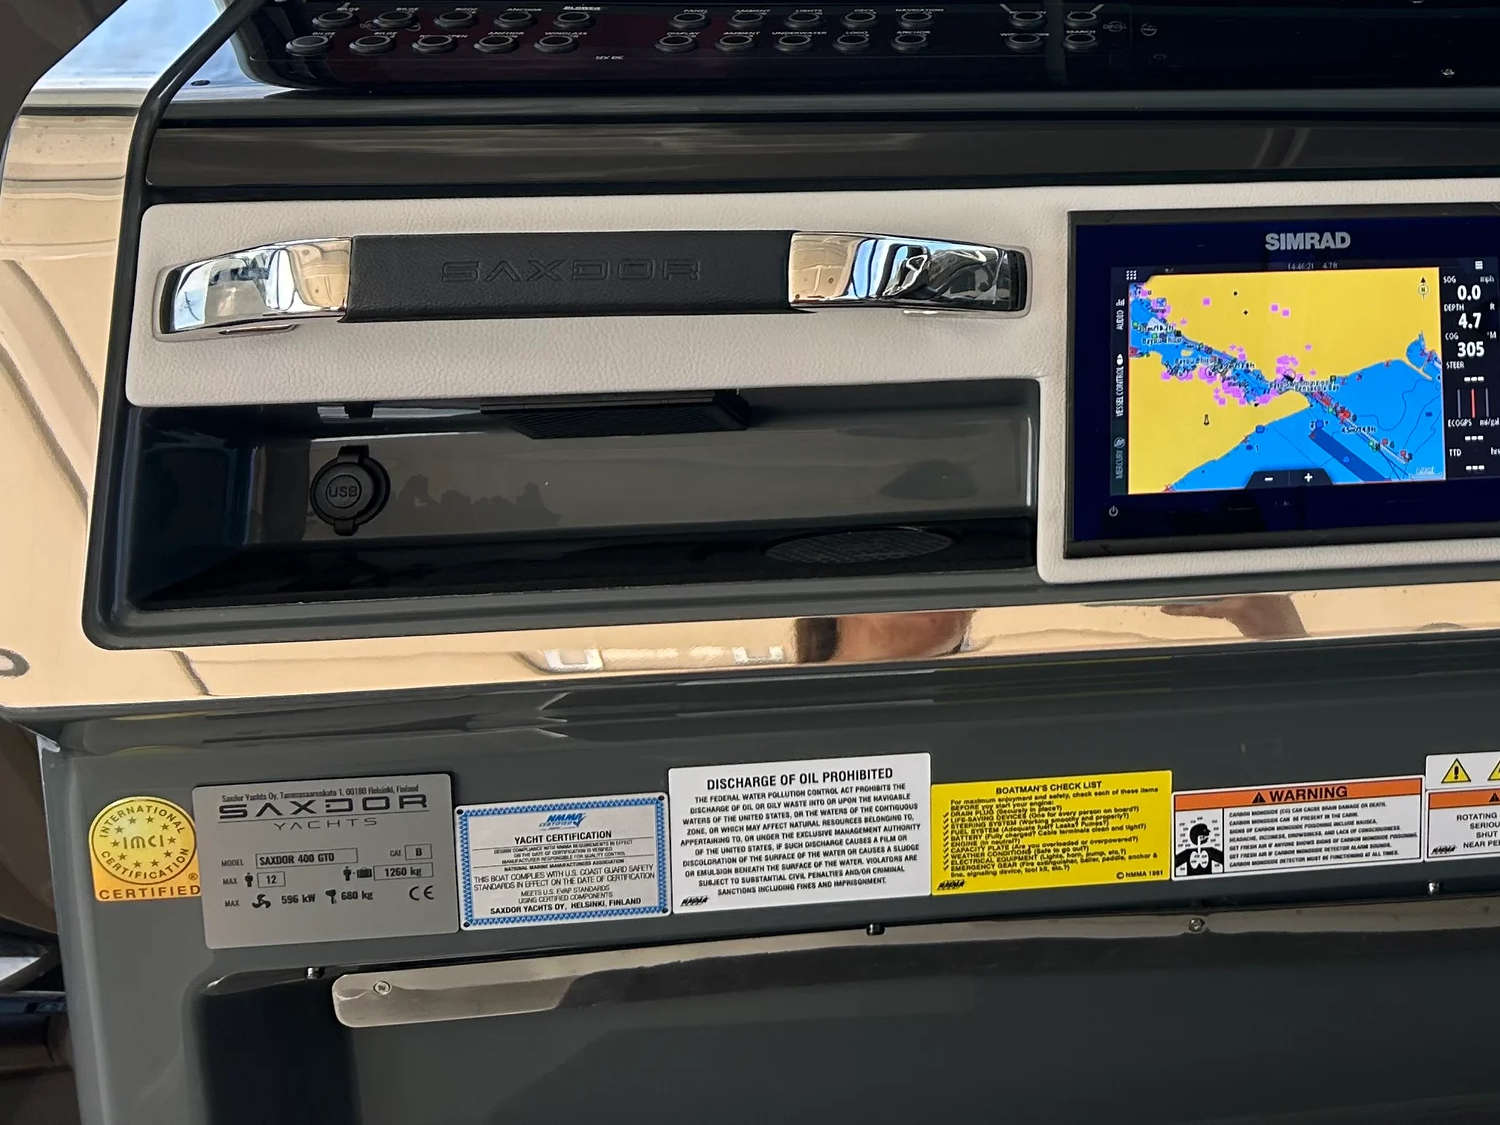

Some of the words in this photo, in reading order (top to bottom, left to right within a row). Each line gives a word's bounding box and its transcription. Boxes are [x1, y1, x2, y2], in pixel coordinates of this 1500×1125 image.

[1265, 231, 1351, 251] SIMRAD
[441, 258, 701, 283] SAXDOR
[1443, 275, 1457, 284] SOG
[1456, 284, 1482, 301] 0.0
[1443, 303, 1465, 312] DEPTH
[1458, 312, 1482, 329] 4.7
[1445, 332, 1459, 340] COG
[1457, 341, 1485, 358] 305
[1446, 360, 1465, 369] STEER
[1447, 418, 1472, 427] ECOGPS
[1448, 448, 1462, 457] TTD
[328, 485, 358, 498] USB
[706, 774, 776, 791] DISCHARGE
[780, 773, 796, 785] OF
[799, 772, 819, 784] OIL
[822, 767, 893, 782] PROHIBITED
[742, 793, 767, 801] WATER
[767, 790, 806, 800] POLLUTION
[807, 787, 839, 797] CONTROL
[855, 784, 892, 793] PROHIBITS
[892, 783, 906, 791] THE
[995, 784, 1048, 795] BOATMAN'S
[1049, 782, 1081, 792] CHECK
[1082, 780, 1102, 790] LIST
[1269, 785, 1348, 803] WARNING
[218, 794, 428, 820] SAXDOR
[99, 805, 186, 838] INTERNATIONAL
[273, 817, 378, 831] YACHTS
[1456, 812, 1498, 821] ROTATING
[122, 834, 165, 850] IMCI
[514, 835, 543, 845] YACHT
[545, 830, 613, 843] CERTIFICATION
[1476, 830, 1498, 839] SHUT
[1463, 840, 1486, 849] NEAR
[100, 848, 189, 880] CERTIFICATION
[221, 859, 244, 867] MODEL
[259, 854, 295, 866] SAXDOR
[297, 853, 315, 864] 400
[384, 867, 407, 877] 1260
[410, 866, 422, 878] kg
[222, 877, 238, 885] MAX
[266, 875, 277, 885] 12
[98, 884, 201, 900] CERTIFIED
[224, 899, 240, 907] MAX
[281, 894, 299, 904] 596
[301, 893, 316, 903] kW
[361, 890, 374, 901] kg
[490, 905, 522, 915] SAXDOR
[523, 903, 553, 913] YACHTS
[608, 897, 642, 907] FINLAND
